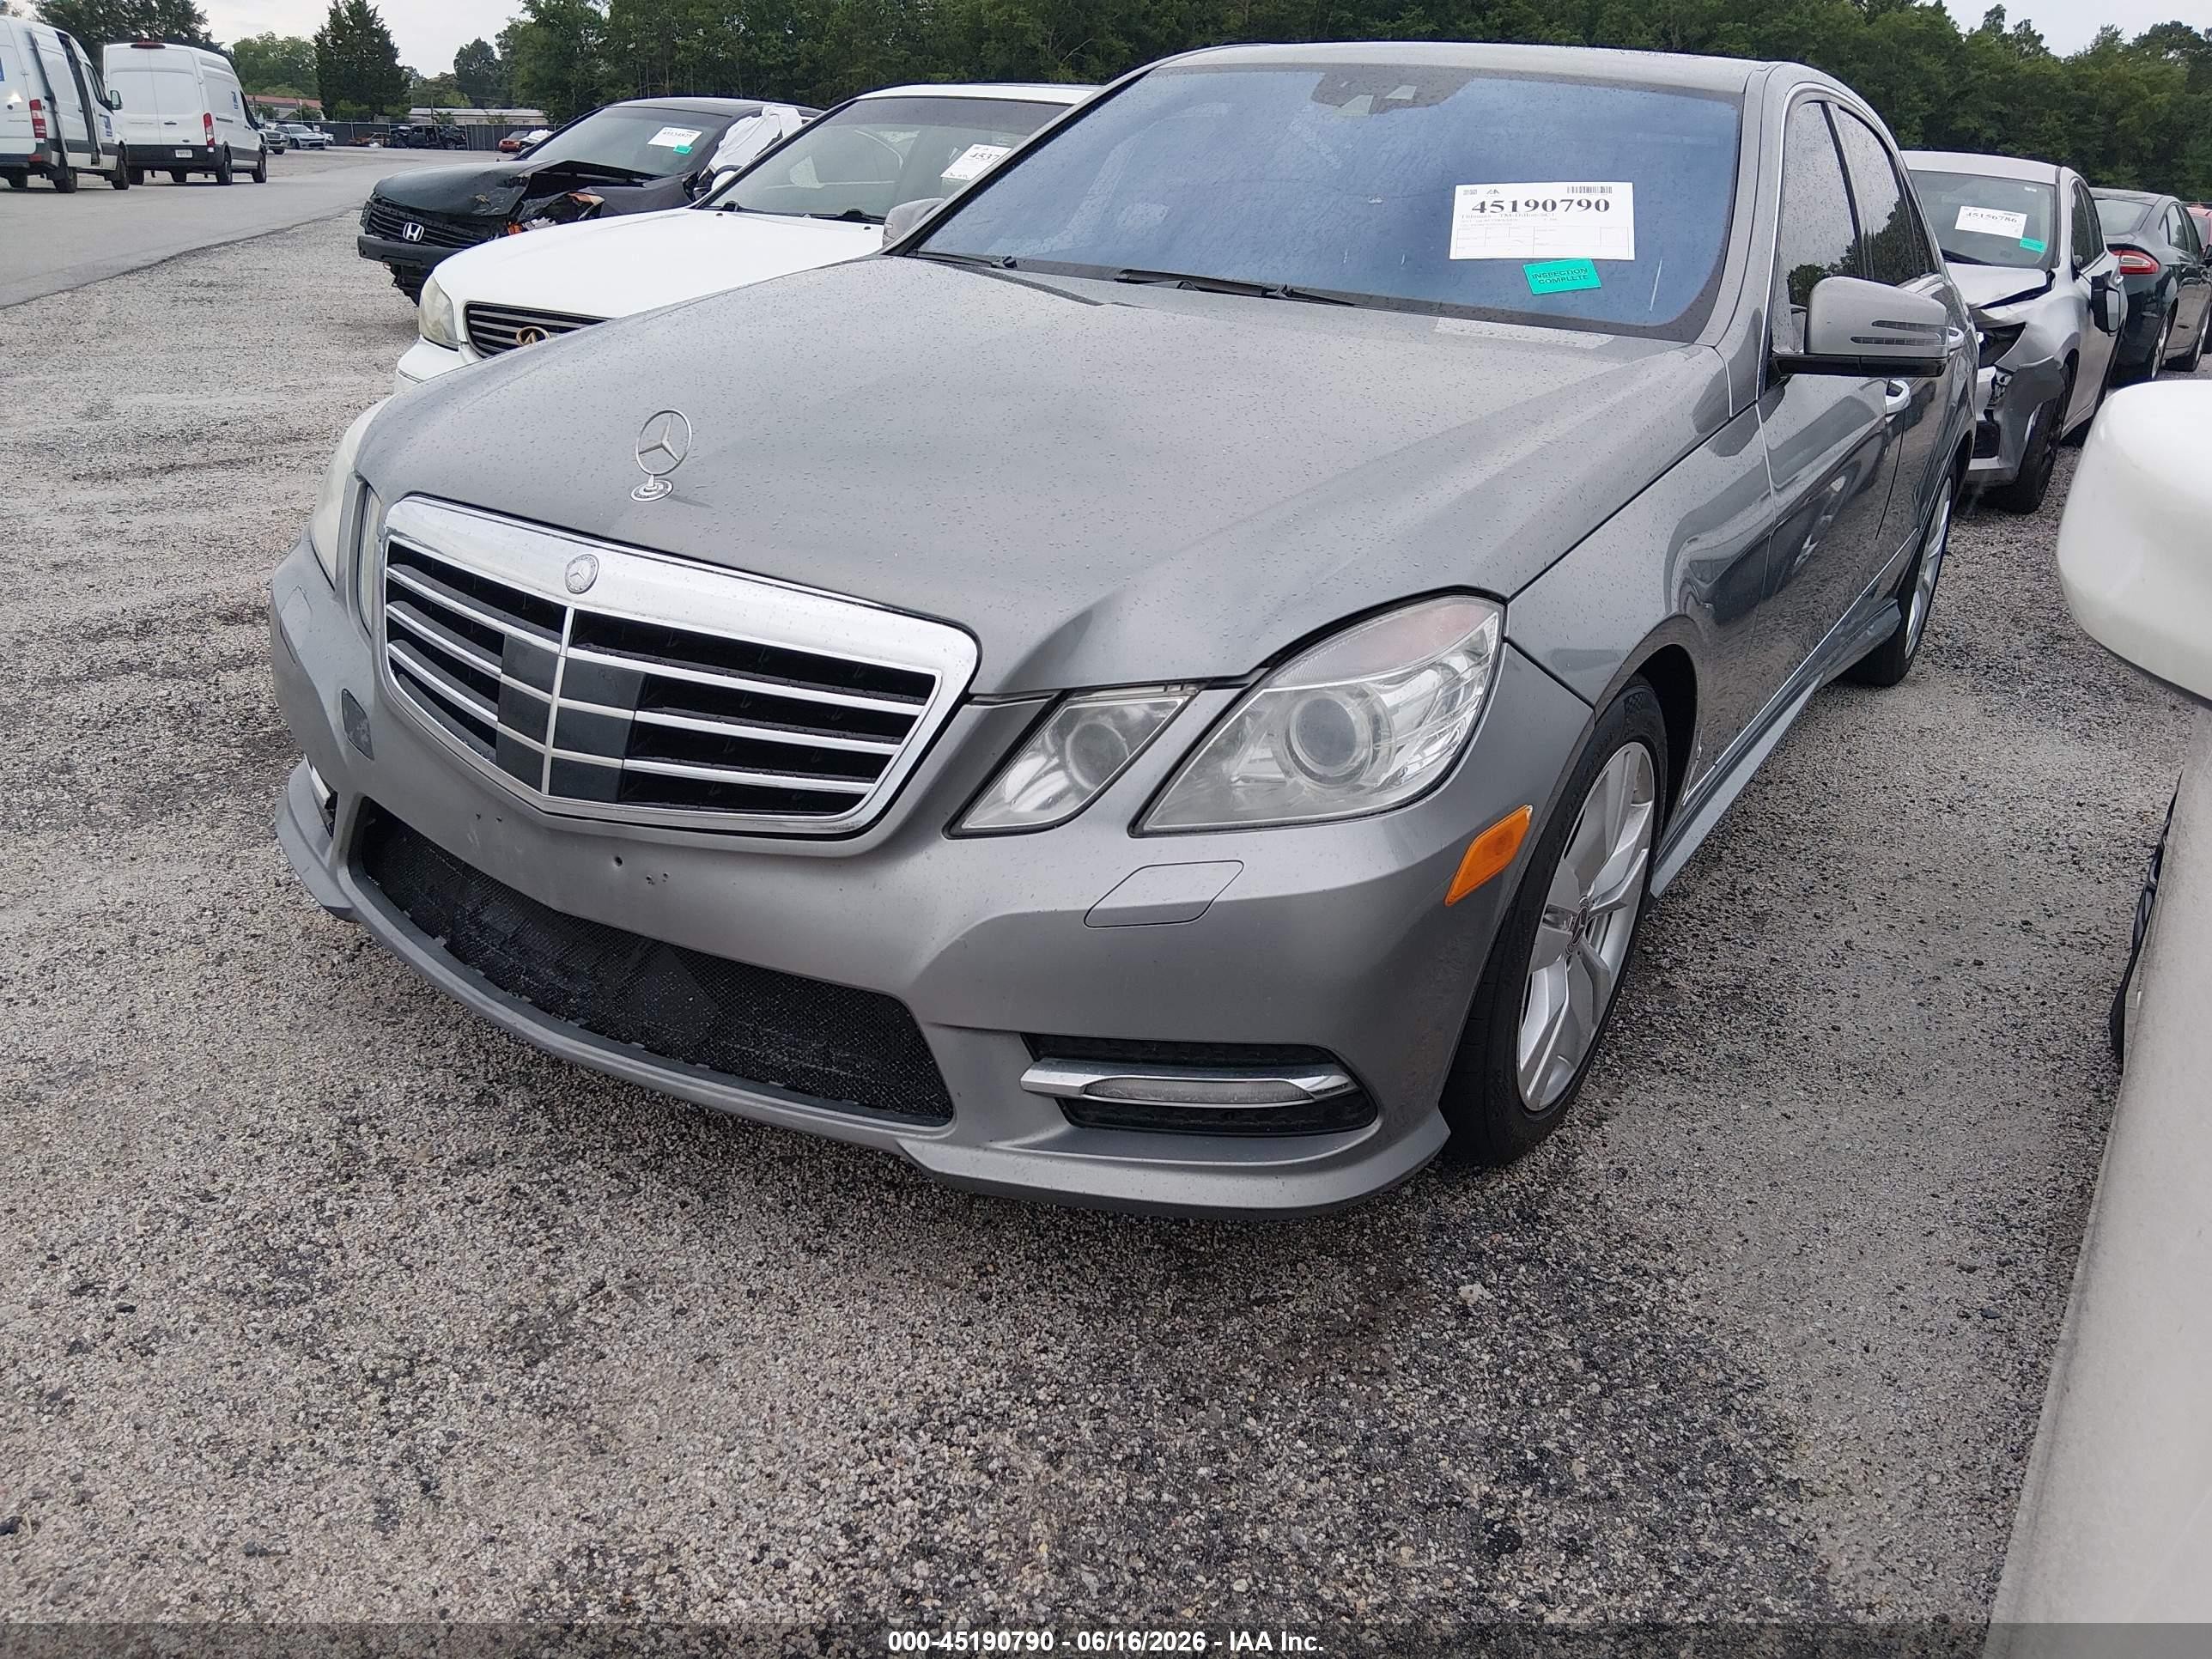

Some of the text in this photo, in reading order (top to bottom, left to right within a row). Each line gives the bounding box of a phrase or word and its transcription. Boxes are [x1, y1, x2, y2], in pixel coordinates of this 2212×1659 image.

[1471, 198, 1611, 214] 45190790
[1532, 267, 1588, 279] INSPECTION
[1538, 274, 1588, 284] COMPLETE
